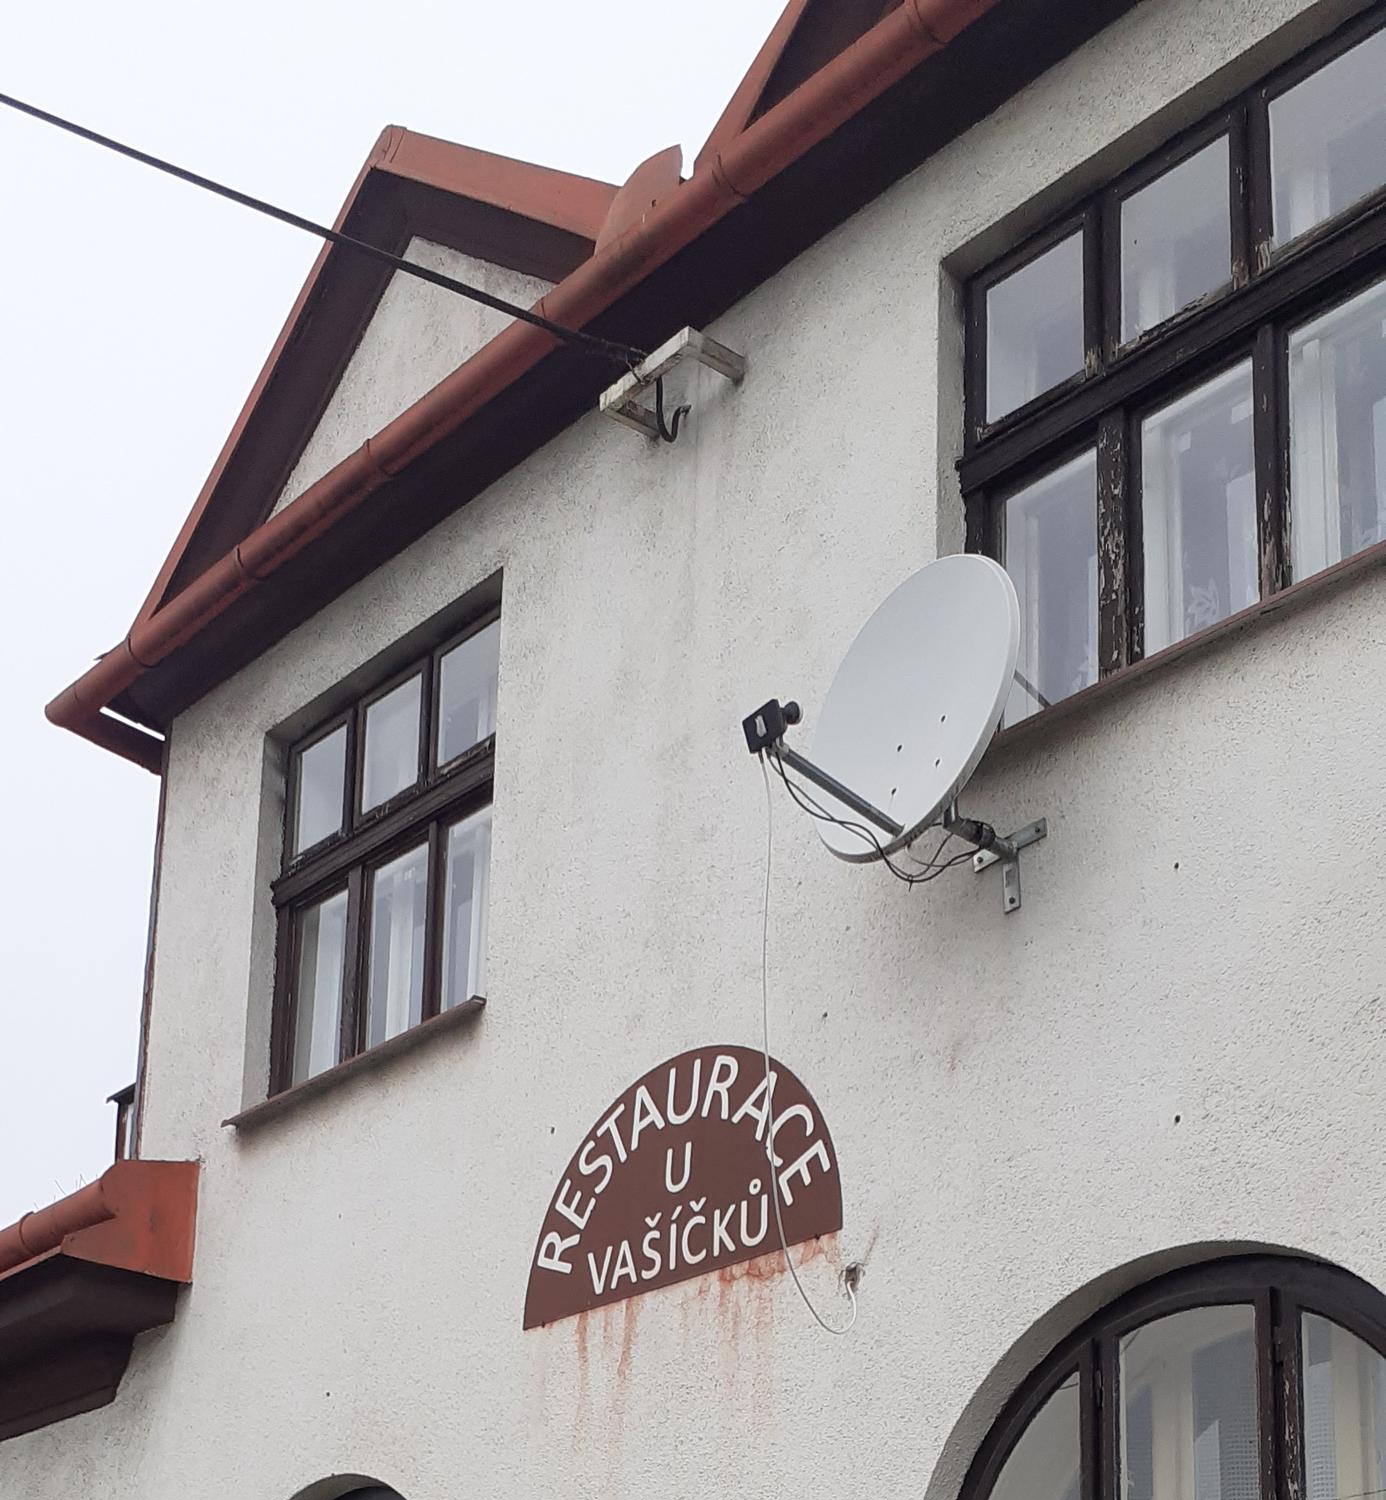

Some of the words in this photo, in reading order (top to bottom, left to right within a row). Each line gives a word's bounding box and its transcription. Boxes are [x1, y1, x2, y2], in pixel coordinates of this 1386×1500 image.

[537, 1055, 831, 1274] RESTAURACE
[665, 1141, 692, 1193] U
[587, 1178, 768, 1295] VAŠÍČKŮ
